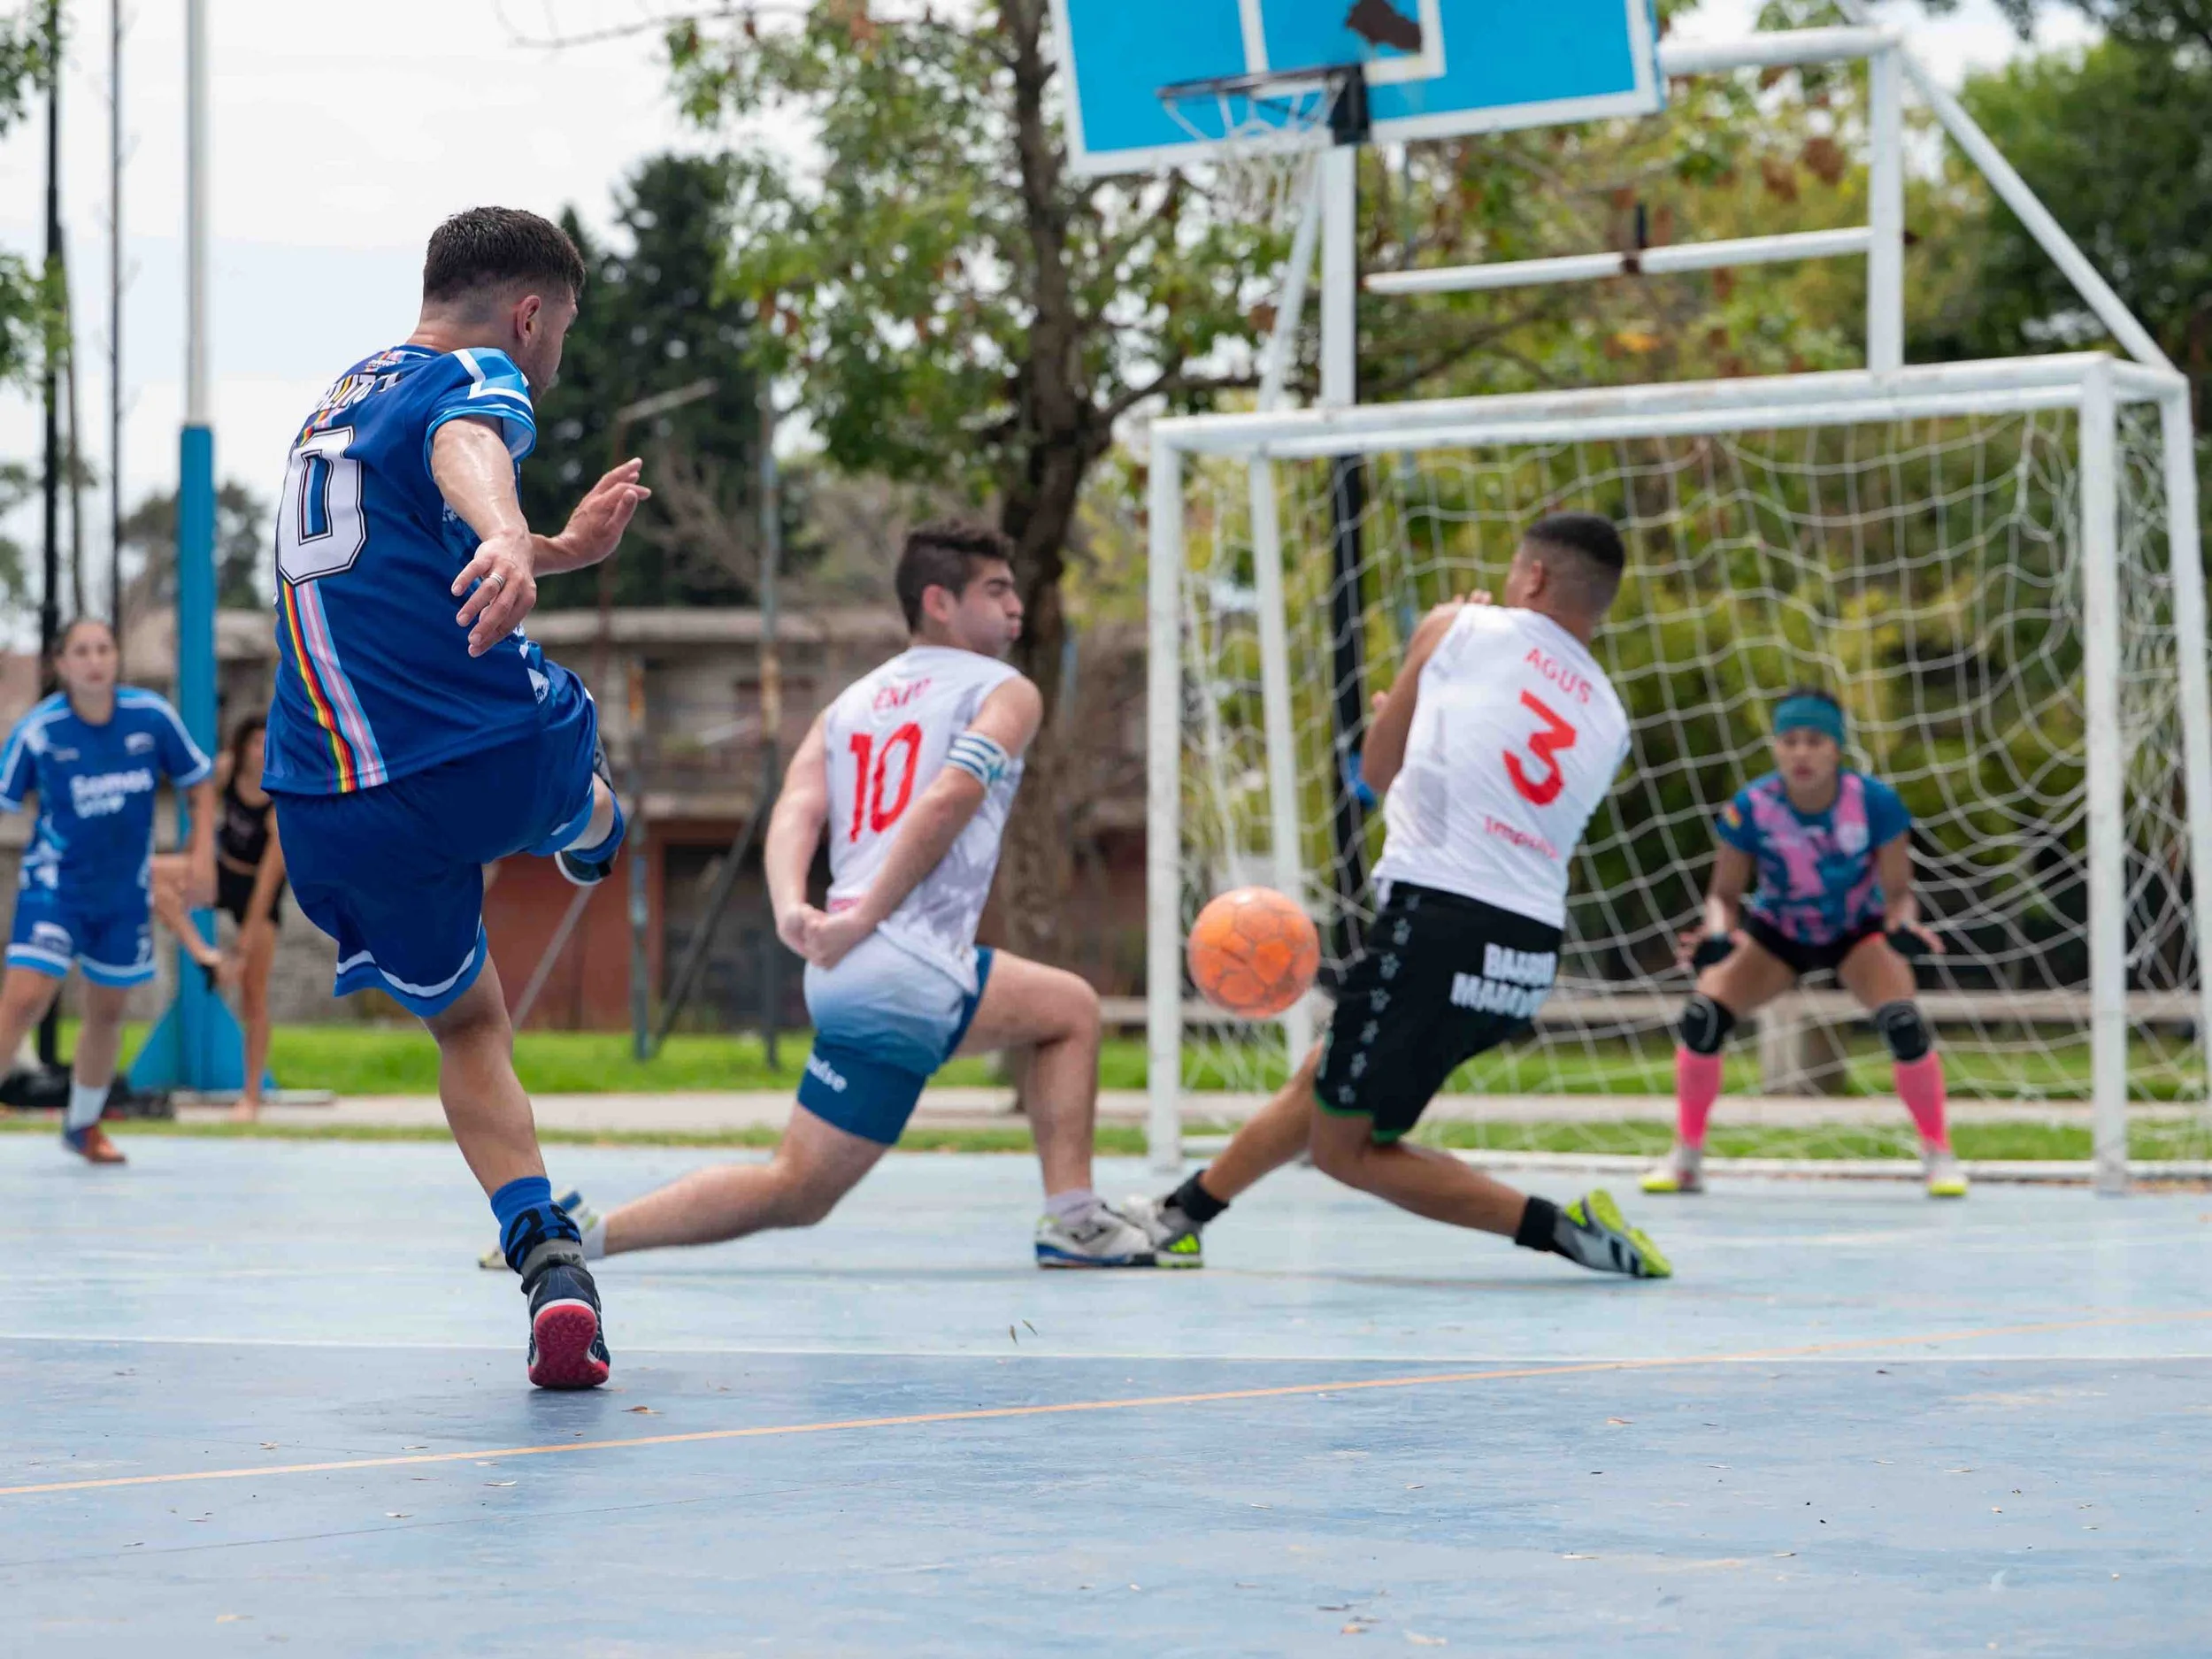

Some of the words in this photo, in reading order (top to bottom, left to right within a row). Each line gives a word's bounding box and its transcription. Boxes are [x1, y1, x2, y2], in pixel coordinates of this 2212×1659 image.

[1524, 648, 1594, 704] AGUS
[849, 720, 923, 842] 10
[1502, 688, 1577, 807] 3
